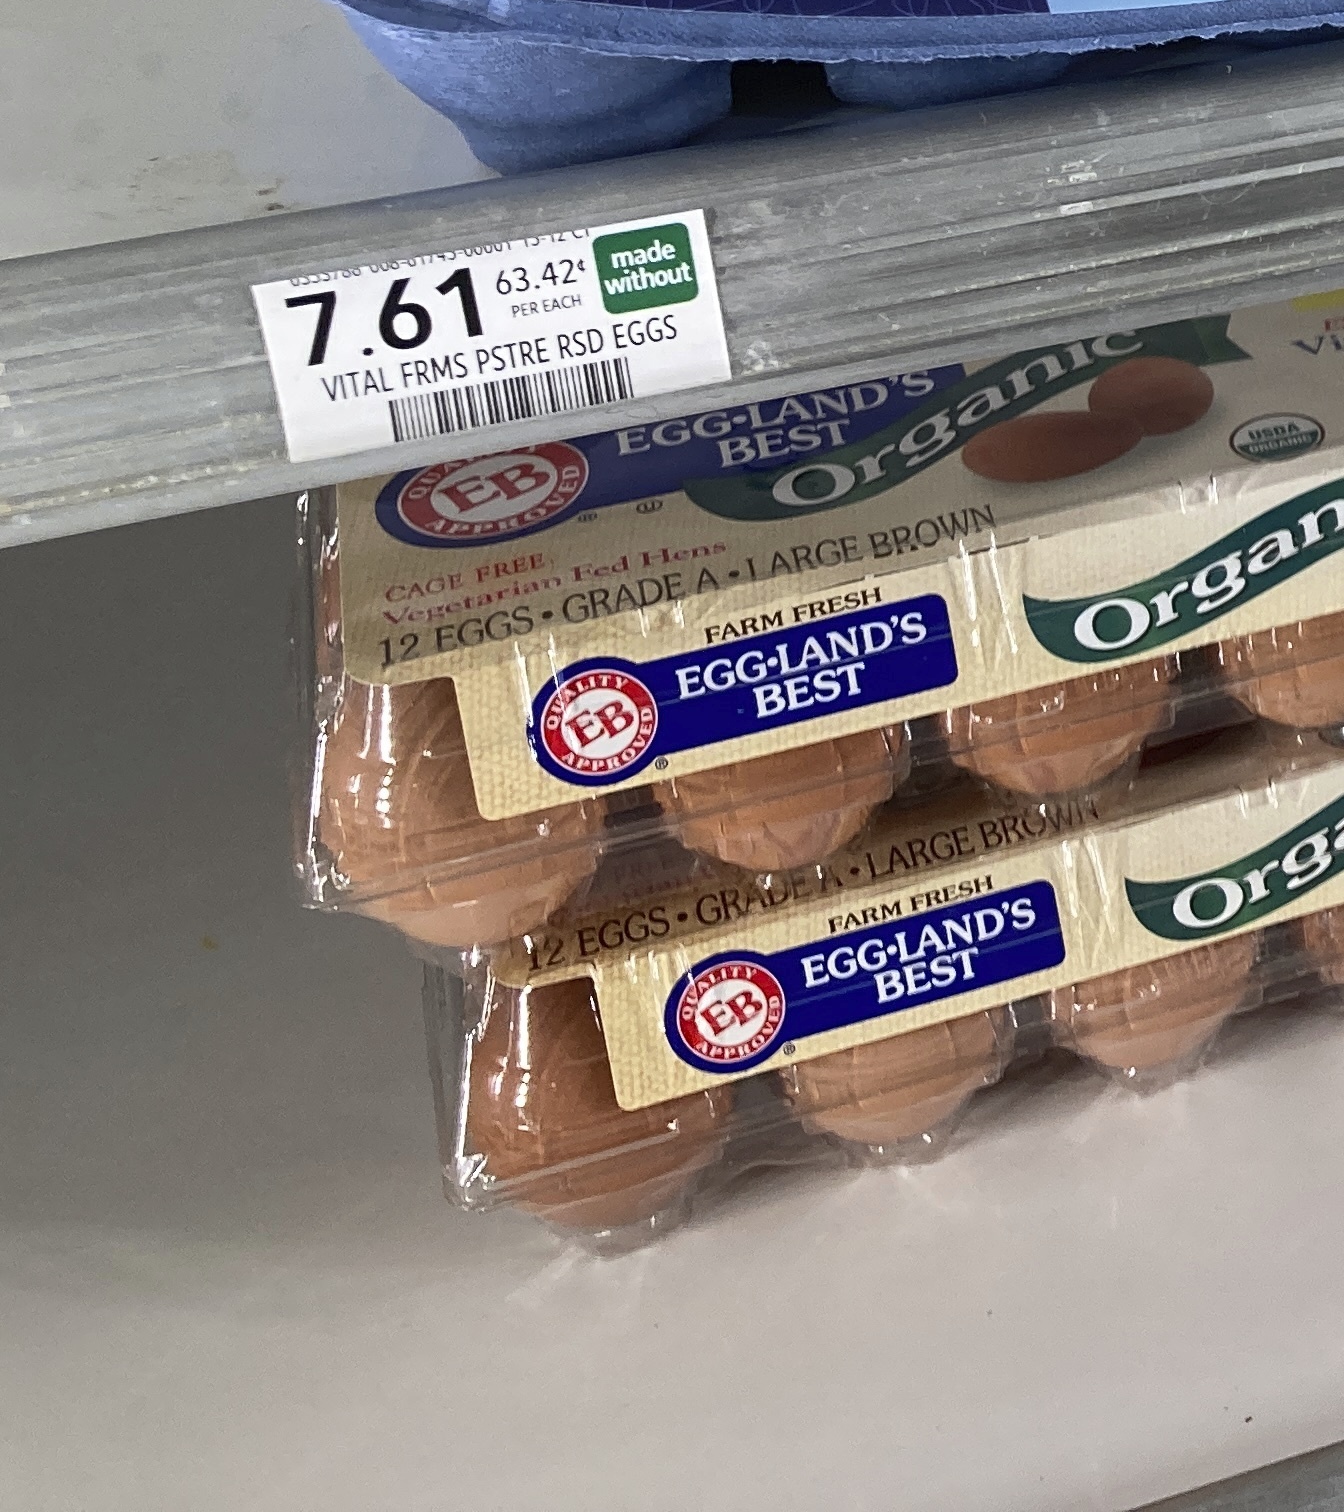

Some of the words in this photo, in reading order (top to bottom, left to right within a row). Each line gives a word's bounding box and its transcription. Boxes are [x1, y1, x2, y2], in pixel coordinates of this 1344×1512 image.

[495, 258, 586, 298] 63.42¢
[604, 260, 693, 297] without
[611, 240, 677, 270] made
[284, 266, 485, 367] 7.61
[511, 301, 540, 319] PER
[543, 294, 582, 314] EACH
[321, 366, 394, 402] VITAL
[400, 352, 469, 388] FRMS
[477, 336, 549, 374] PSTRE
[558, 328, 603, 360] RSD
[614, 315, 678, 350] EGGS
[717, 418, 850, 468] BEST
[772, 329, 1144, 507] Organic
[382, 575, 562, 625] Vegetarian
[435, 605, 534, 653] EGGS
[562, 572, 687, 624] GRADE
[705, 609, 784, 645] FARM
[794, 587, 883, 623] FRESH
[546, 674, 629, 731] QUALITY
[753, 662, 865, 718] BEST
[561, 706, 653, 772] APPROVED
[565, 699, 635, 747] EB
[577, 906, 671, 957] EGGS
[695, 874, 813, 925] GRADE
[865, 827, 975, 879] LARGE
[828, 899, 902, 935] FARM
[910, 874, 994, 912] FRESH
[681, 965, 757, 1021] QUALITY
[873, 947, 979, 1004] BEST
[694, 995, 780, 1059] APPROVED
[701, 990, 763, 1037] EB
